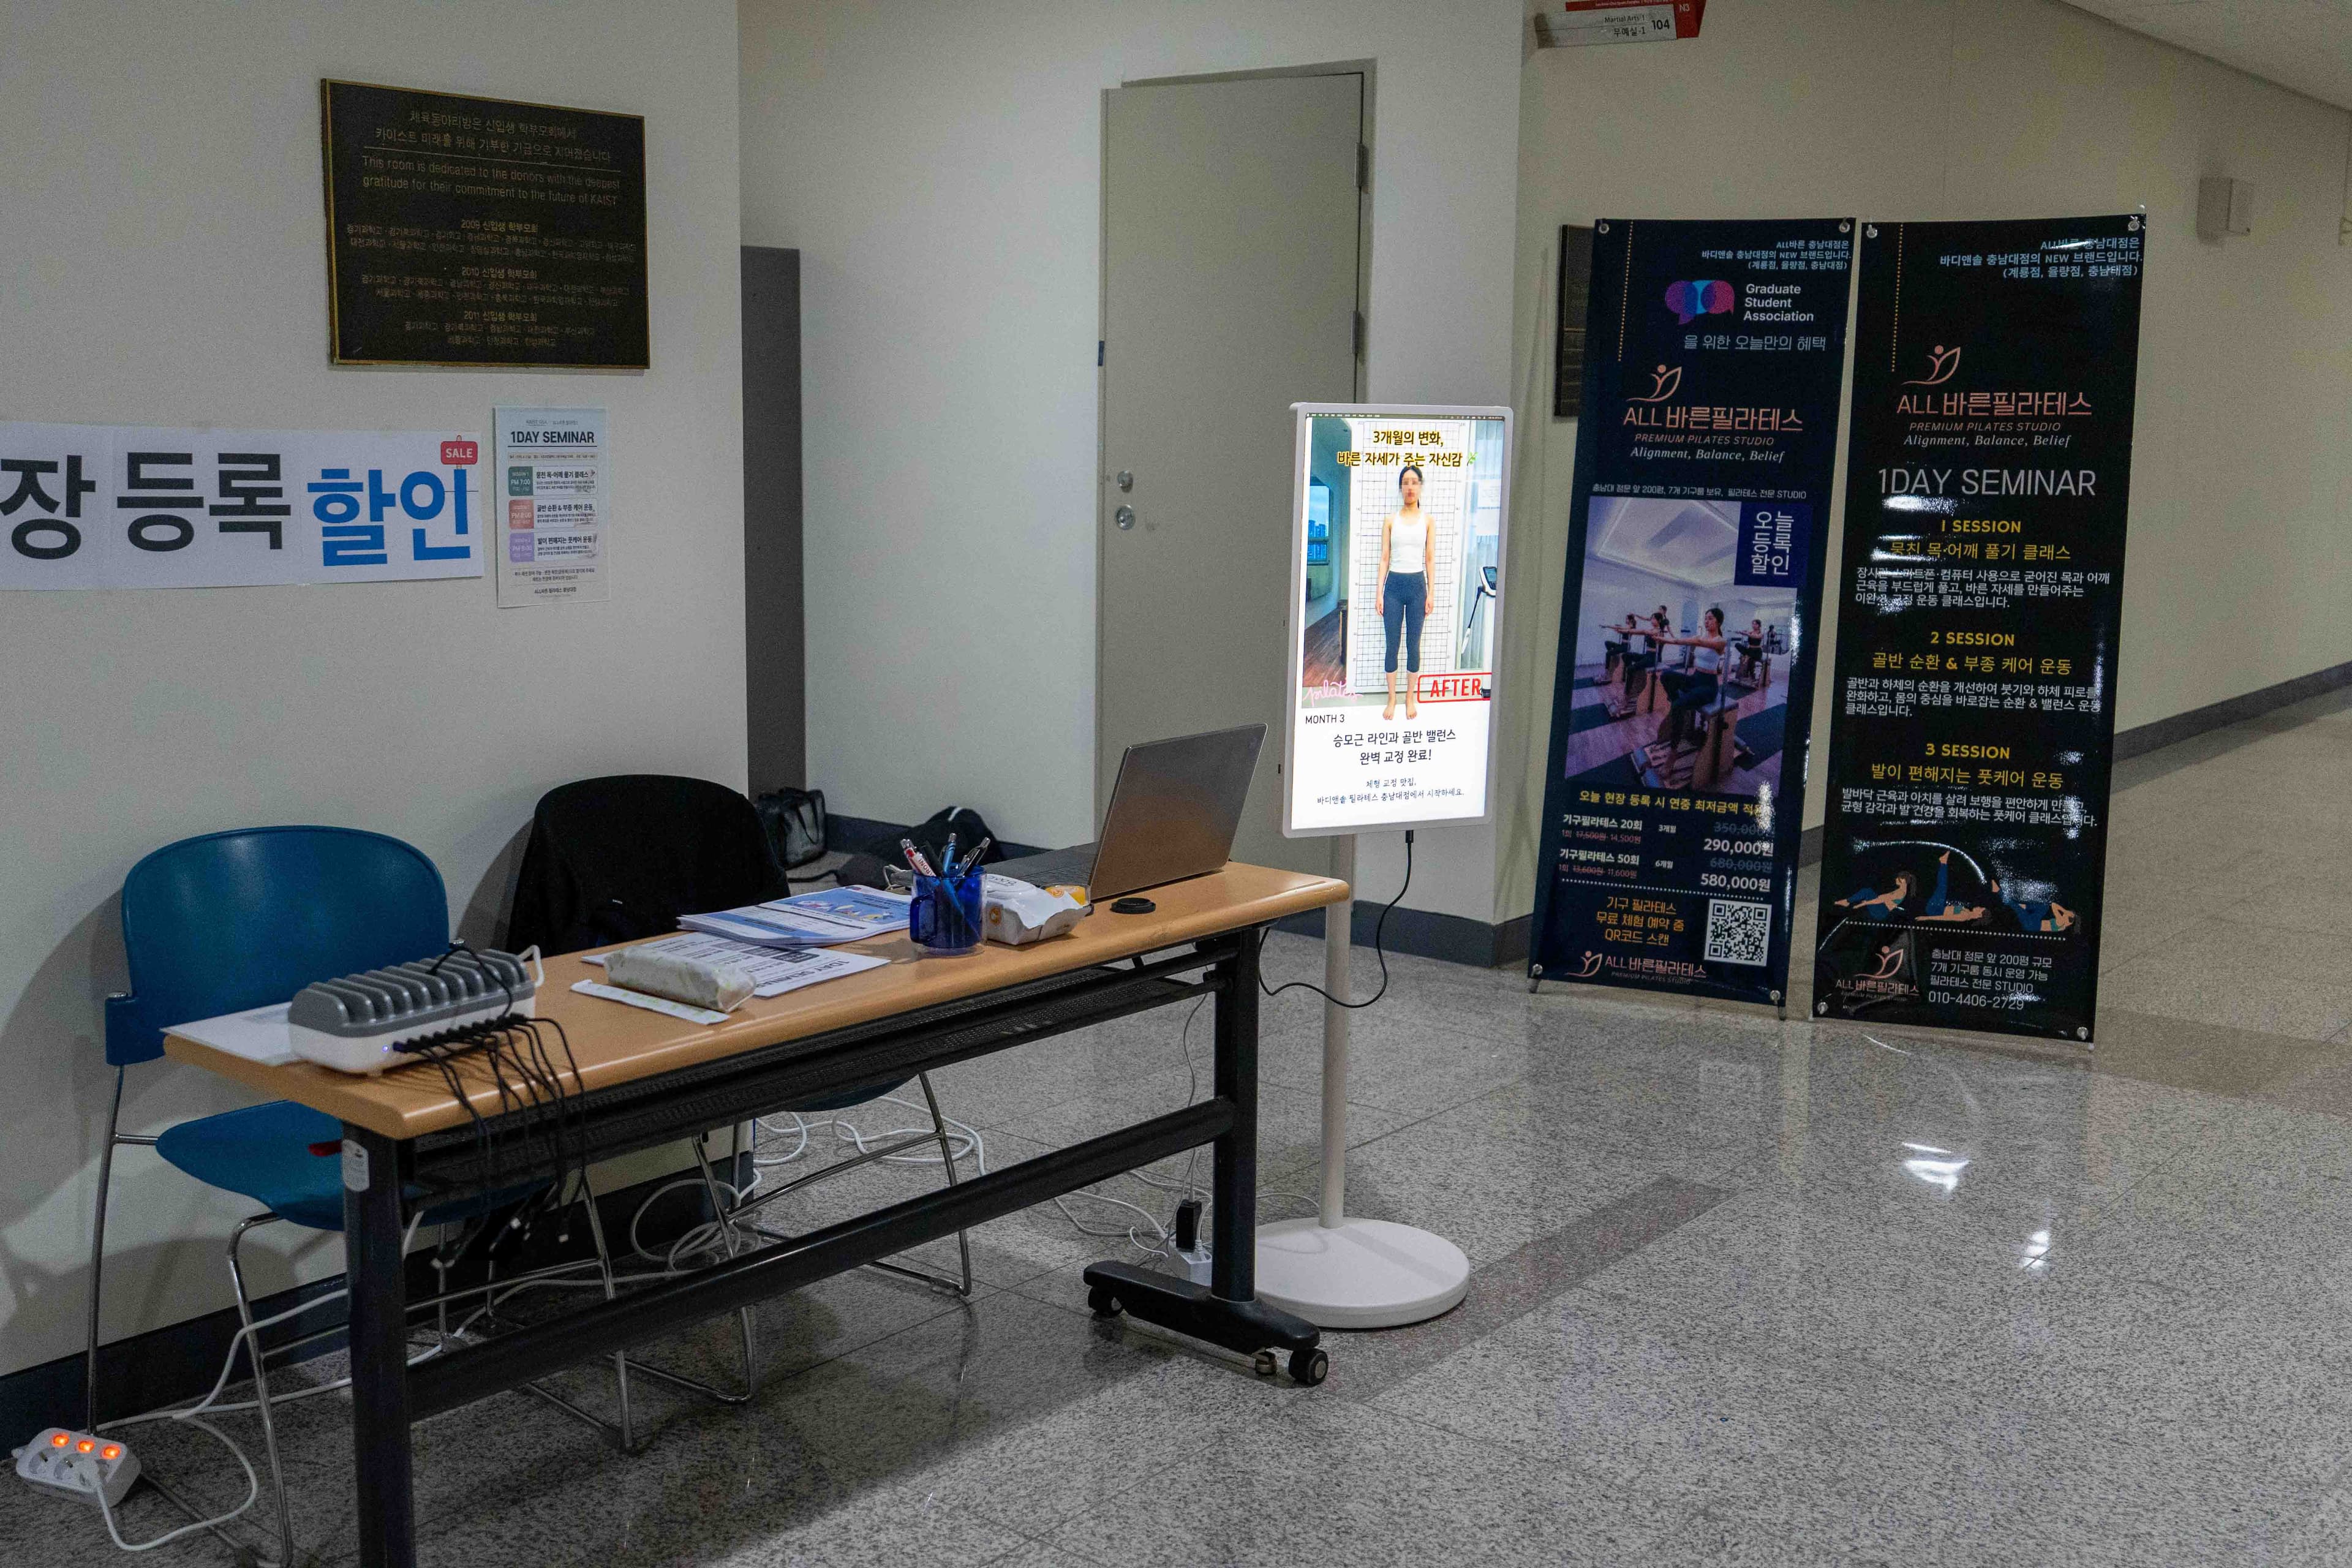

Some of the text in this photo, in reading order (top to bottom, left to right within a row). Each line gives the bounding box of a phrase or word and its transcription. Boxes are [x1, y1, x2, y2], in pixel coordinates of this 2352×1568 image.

[1651, 20, 1670, 29] 104
[486, 119, 514, 134] 신입생
[375, 127, 418, 143] 카이스트
[421, 132, 452, 146] 미래를
[456, 136, 475, 150] 위해
[479, 138, 510, 153] 기부한
[513, 142, 551, 157] 기금으로
[363, 155, 620, 190] This room is dedicated to the donors with the deepest
[363, 176, 617, 206] gratitude for their commitment to the future of KAIST
[1940, 251, 2143, 266] 바디앤솔 충남대점의 NEW 브랜드입니다.
[461, 266, 537, 279] 2010 신입생 학부모회
[2002, 265, 2044, 279] (계룡점,
[1746, 284, 1801, 294] Graduate
[1744, 297, 1792, 307] Student
[1743, 311, 1814, 322] Association
[1684, 334, 1826, 351] 을 위한 오늘만의 혜택
[1896, 392, 2092, 416] ALL 바른필라테스
[1623, 406, 1803, 431] ALL 바른필라테스
[1909, 422, 2062, 432] PREMIUM PILATES STUDIO
[510, 431, 594, 443] 1DAY SEMINAR
[1373, 431, 1444, 447] 3개월의 변화,
[1634, 433, 1774, 446] PREMIUM PILATES STUDIO
[1904, 435, 2072, 448] Alignment, Balance, Belief
[445, 448, 474, 459] SALE
[1338, 451, 1463, 467] 바른 자세가 주는 자신감
[1630, 447, 1785, 464] Alignment, Balance, Belief
[1879, 469, 2096, 496] 1DAY SEMINAR
[0, 452, 471, 566] 장 등록 할인
[1754, 511, 1795, 532] 오늘
[1953, 519, 2021, 533] SESSION
[1752, 532, 1793, 553] 등록
[1751, 554, 1790, 575] 할인
[1855, 579, 2084, 598] 근육을 부드럽게 풀고, 바른 자세를 만들어주는
[1930, 631, 2015, 647] 2 SESSION
[1873, 652, 2072, 675] 골반 순환 & 부종 케어 운동
[1430, 678, 1482, 697] AFTER
[1845, 702, 1913, 717] 클래스입니다.
[1306, 714, 1345, 724] MONTH 3
[1333, 729, 1457, 747] 승모근 라인과 골반 밸런스
[1360, 749, 1432, 766] 완벽 교정 완료!
[1925, 743, 2010, 760] 3 SESSION
[1872, 763, 2064, 790] 발이 편해지는 풋케어 운동
[1349, 794, 1379, 804] 필라테스
[1381, 790, 1424, 802] 충남대점에서
[1427, 788, 1464, 799] 시작하세요.
[1563, 813, 1642, 831] 기구필라테스 20회
[1659, 824, 1676, 833] 3개월
[1704, 838, 1774, 857] 290,000원
[1559, 848, 1640, 865] 기구필라테스 50회
[1700, 873, 1771, 892] 580,000원
[1607, 897, 1676, 915] 기구 필라테스
[1596, 911, 1684, 932] 무료 체험 예약 중
[1605, 929, 1669, 946] QR코드 스캔
[815, 960, 850, 972] 1DAY
[1930, 974, 2034, 993] 필라테스 전문 STUDIO
